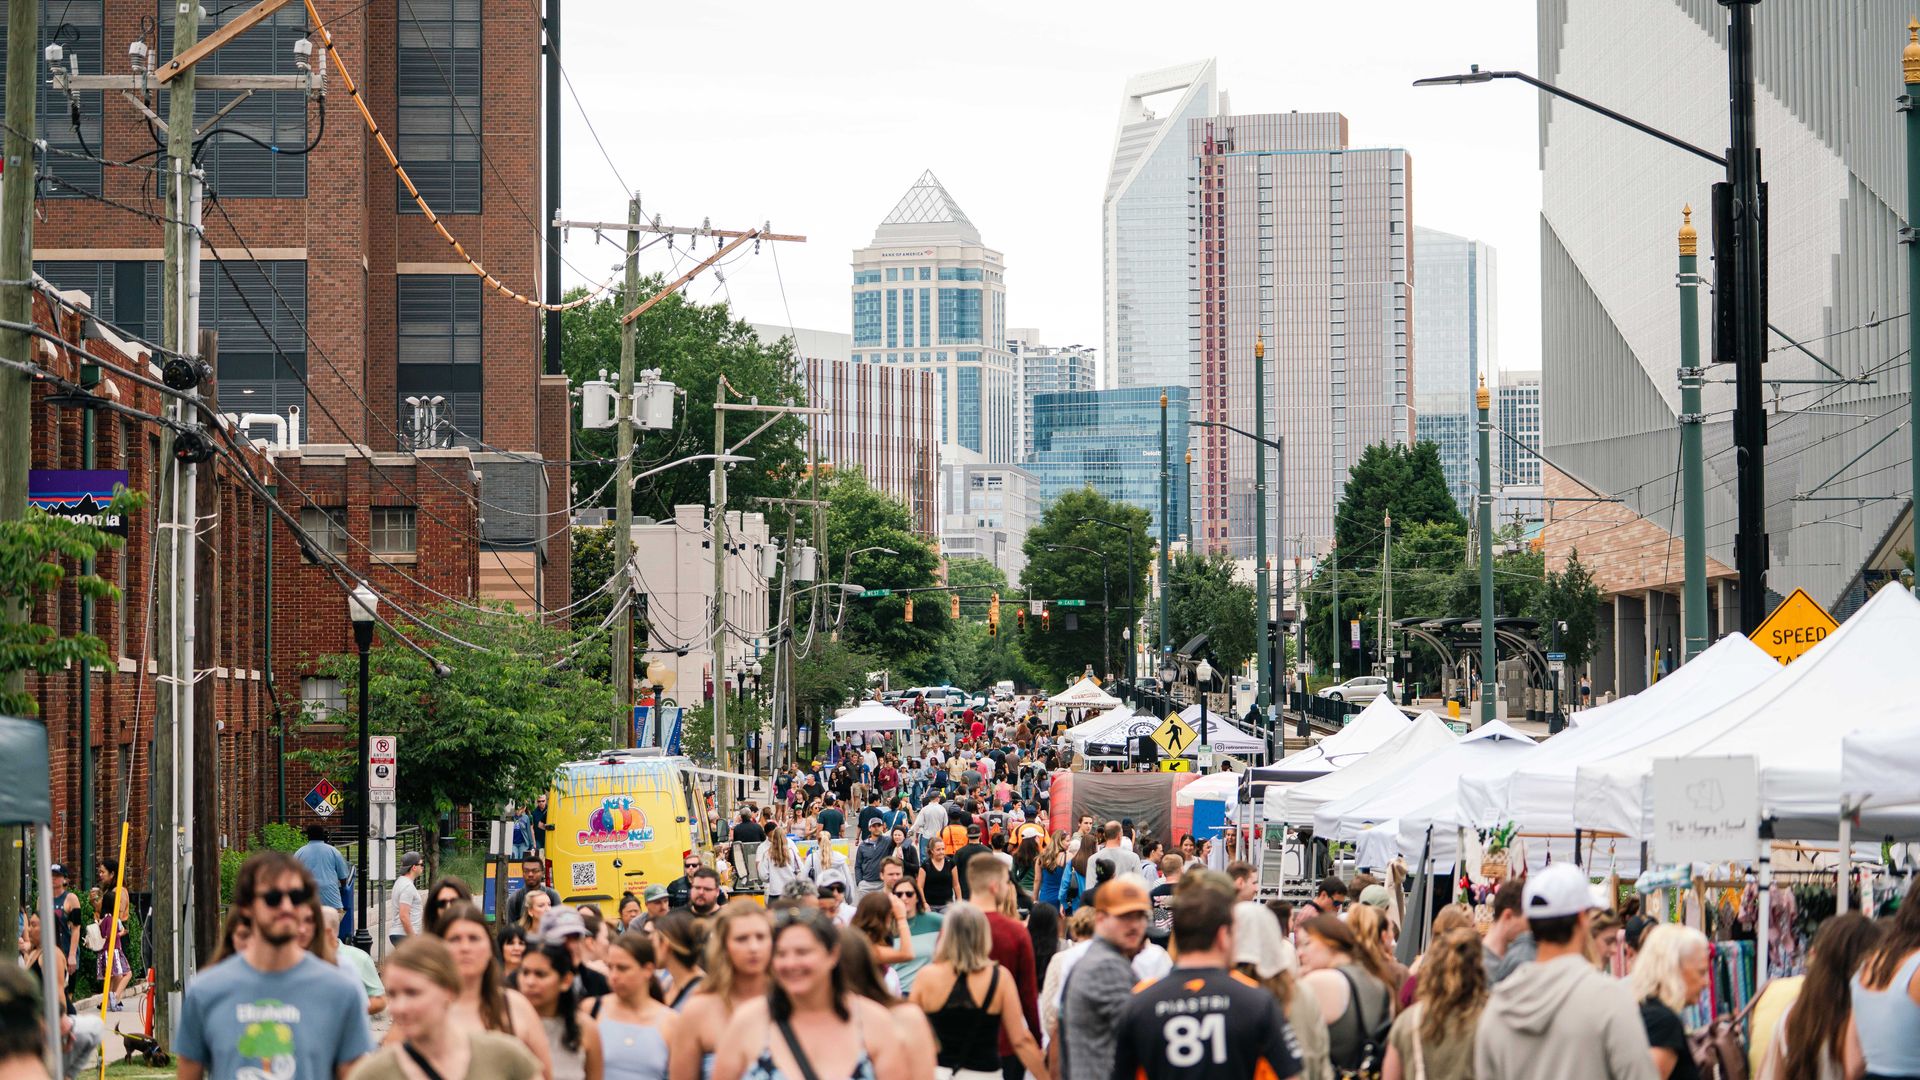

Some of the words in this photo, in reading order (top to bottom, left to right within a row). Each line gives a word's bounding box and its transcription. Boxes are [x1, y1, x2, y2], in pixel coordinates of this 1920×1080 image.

[1772, 626, 1827, 645] SPEED
[321, 784, 328, 795] 0
[1155, 995, 1231, 1016] PIASTRI
[1163, 1013, 1228, 1068] 81
